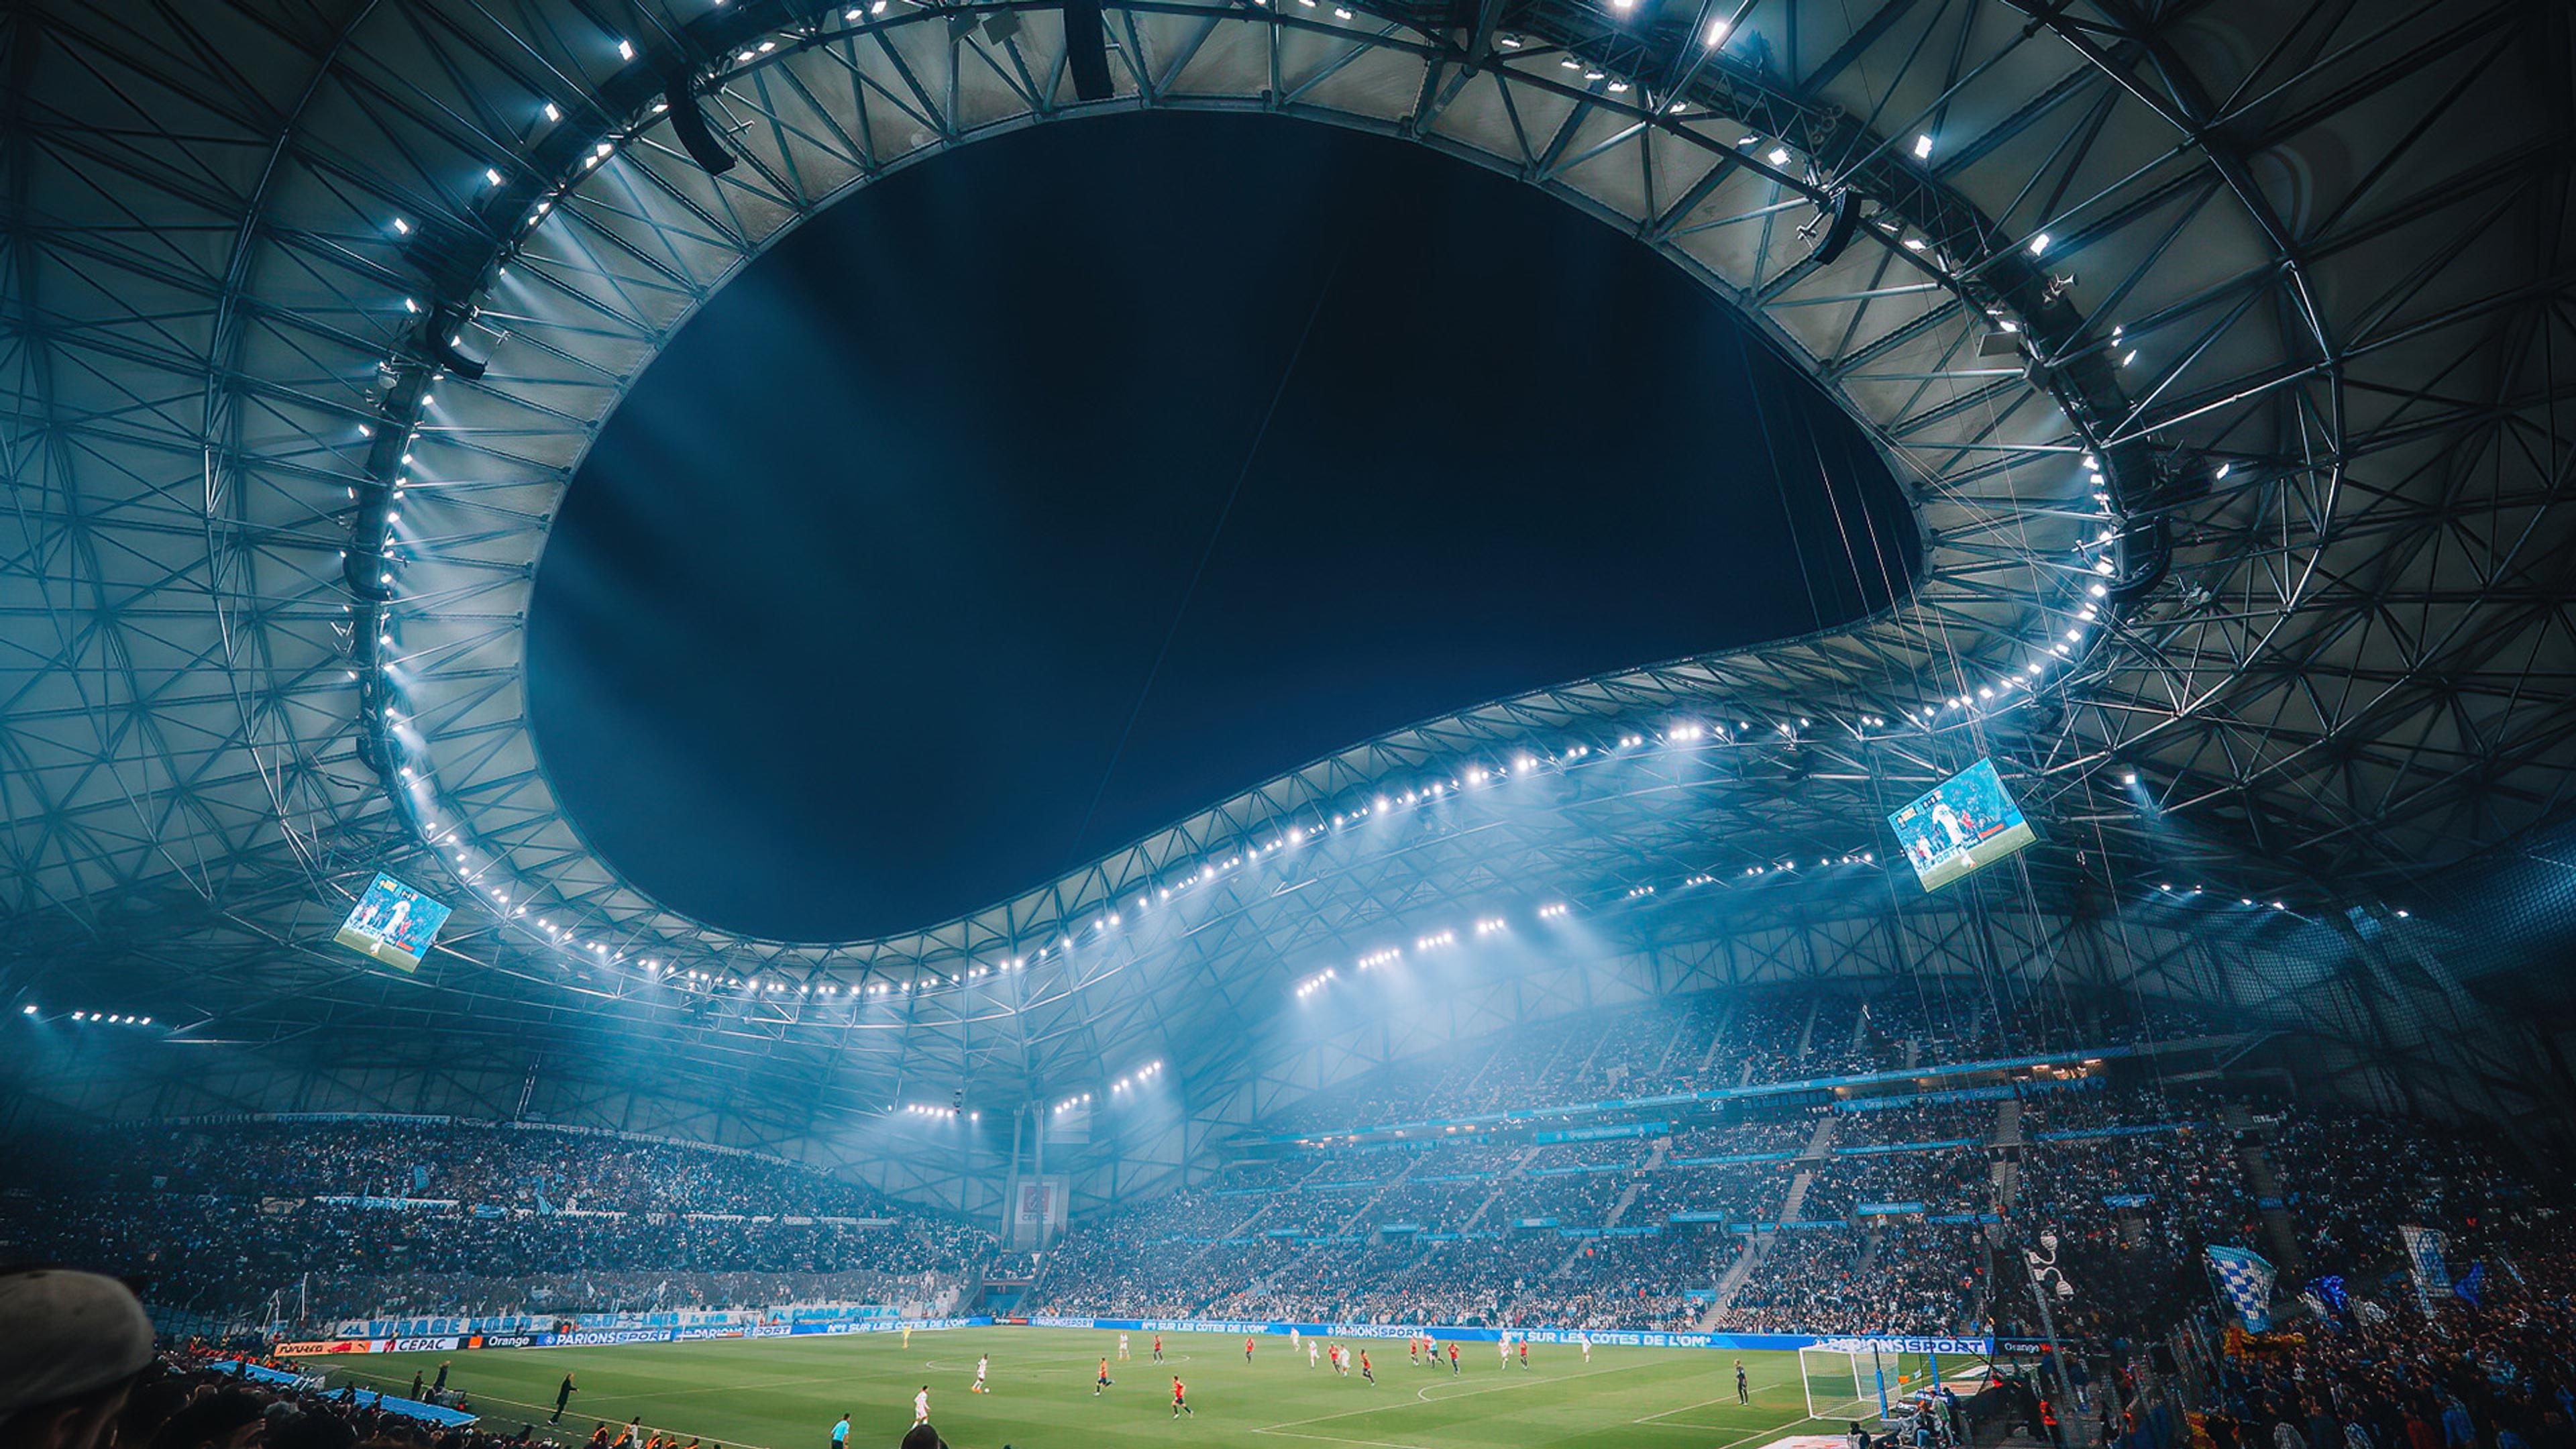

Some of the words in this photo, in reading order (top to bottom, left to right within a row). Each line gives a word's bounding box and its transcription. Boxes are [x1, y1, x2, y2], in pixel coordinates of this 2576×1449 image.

[369, 1319, 462, 1336] VIRAGE
[398, 1338, 445, 1351] CEPAC
[488, 1336, 530, 1347] Orange
[556, 1332, 616, 1346] PARIONS
[619, 1331, 670, 1342] SPORT
[1527, 1332, 1556, 1342] SUR
[1643, 1334, 1666, 1346] DE
[1907, 1342, 1982, 1352] SPORT
